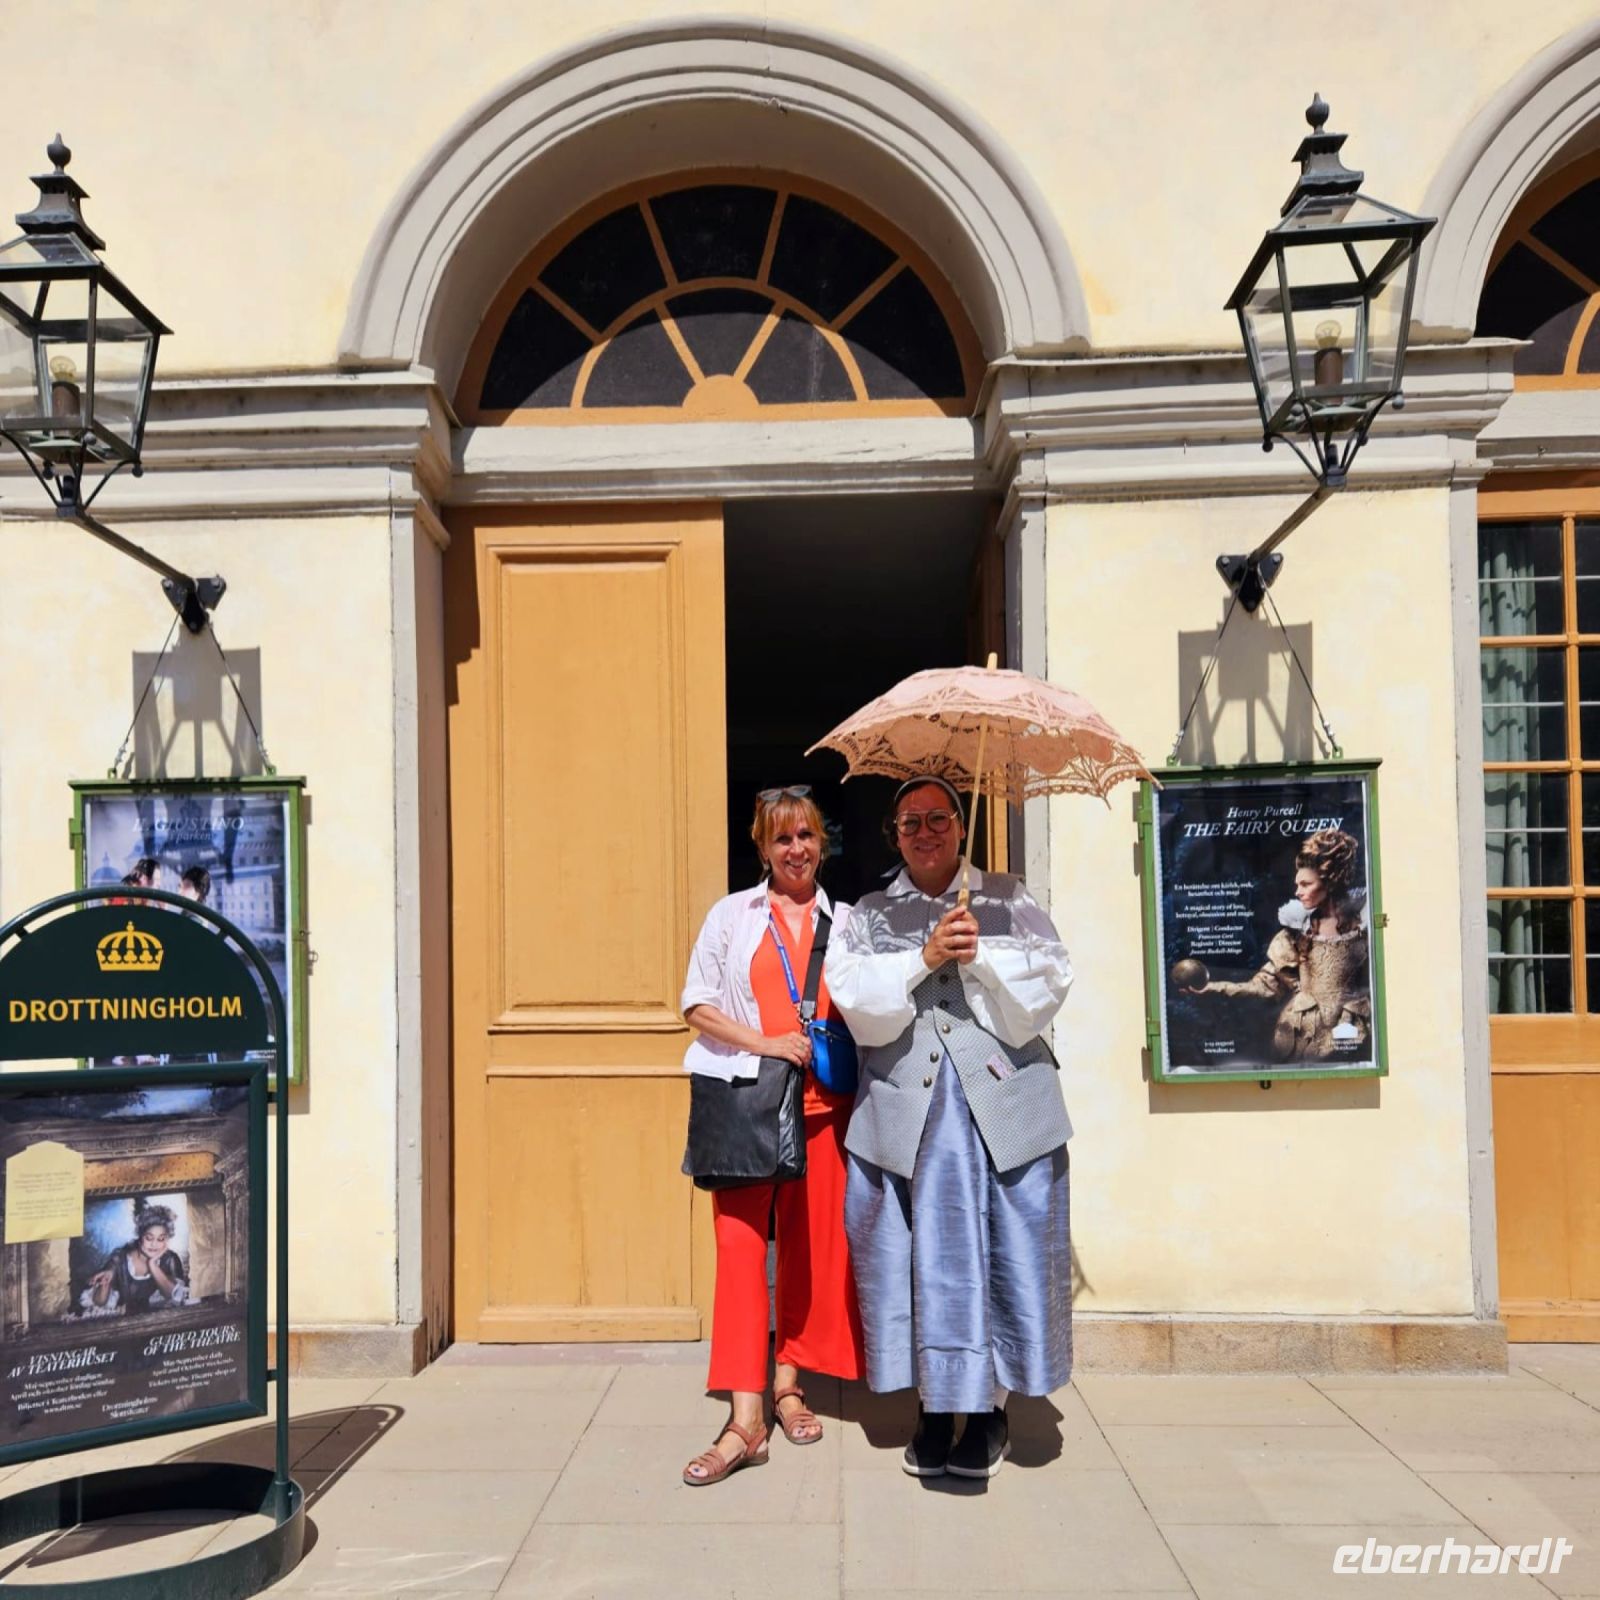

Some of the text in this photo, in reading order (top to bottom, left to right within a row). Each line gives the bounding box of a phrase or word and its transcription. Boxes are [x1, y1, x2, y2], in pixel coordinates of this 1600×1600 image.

[1227, 804, 1303, 820] Henry Purcell
[1184, 817, 1344, 837] THE FAIRY QUEEN
[8, 996, 242, 1022] DROTTNINGHOLM
[149, 1331, 197, 1347] GUIDED
